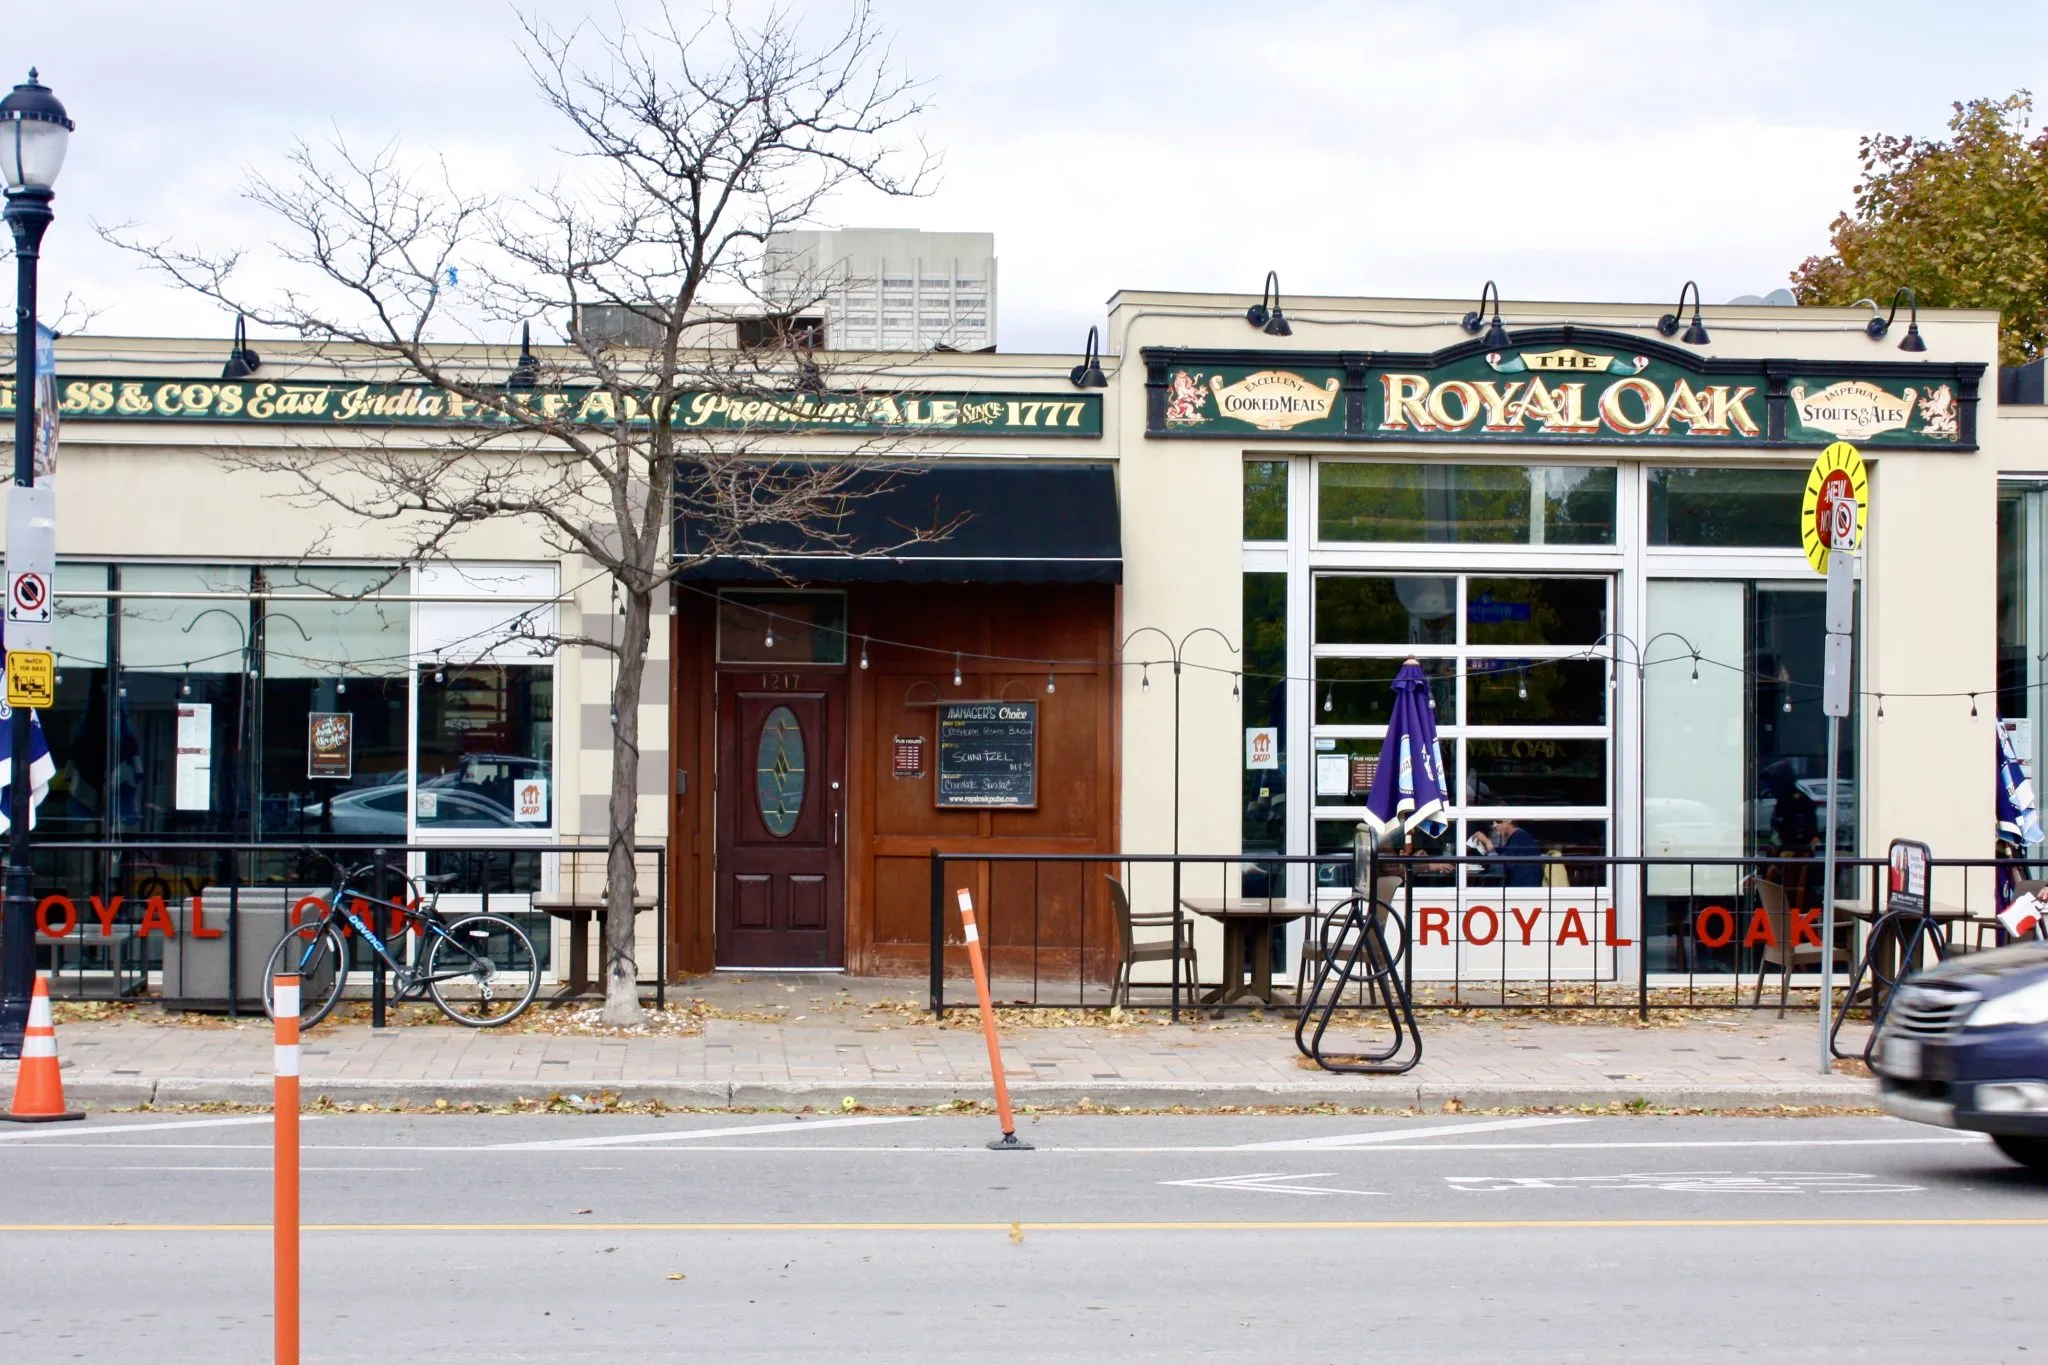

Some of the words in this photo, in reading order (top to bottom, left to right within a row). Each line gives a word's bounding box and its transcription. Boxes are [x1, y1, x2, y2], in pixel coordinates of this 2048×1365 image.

[1535, 355, 1598, 368] THE
[1244, 376, 1305, 393] EXCELLENT
[1224, 394, 1279, 413] COOKED
[1279, 395, 1325, 413] MEALS
[1823, 386, 1880, 403] IMPERIAL
[246, 383, 346, 419] East
[333, 385, 444, 420] India
[862, 396, 960, 427] ALE
[961, 401, 1003, 425] SINCE
[1004, 401, 1086, 426] 1777
[1378, 373, 1600, 432] ROYAL
[1597, 376, 1760, 437] OAK
[1803, 404, 1858, 422] STOUTS
[1869, 405, 1904, 424] ALES
[1826, 480, 1847, 504] NEW
[762, 672, 801, 690] 1217
[947, 707, 996, 720] MANAGER'S
[998, 707, 1028, 720] Choice
[1251, 753, 1271, 763] SKIP
[520, 806, 540, 815] SKIP
[0, 895, 223, 938] OYAL
[1418, 905, 1633, 947] ROYAL
[1695, 905, 1824, 948] OAK
